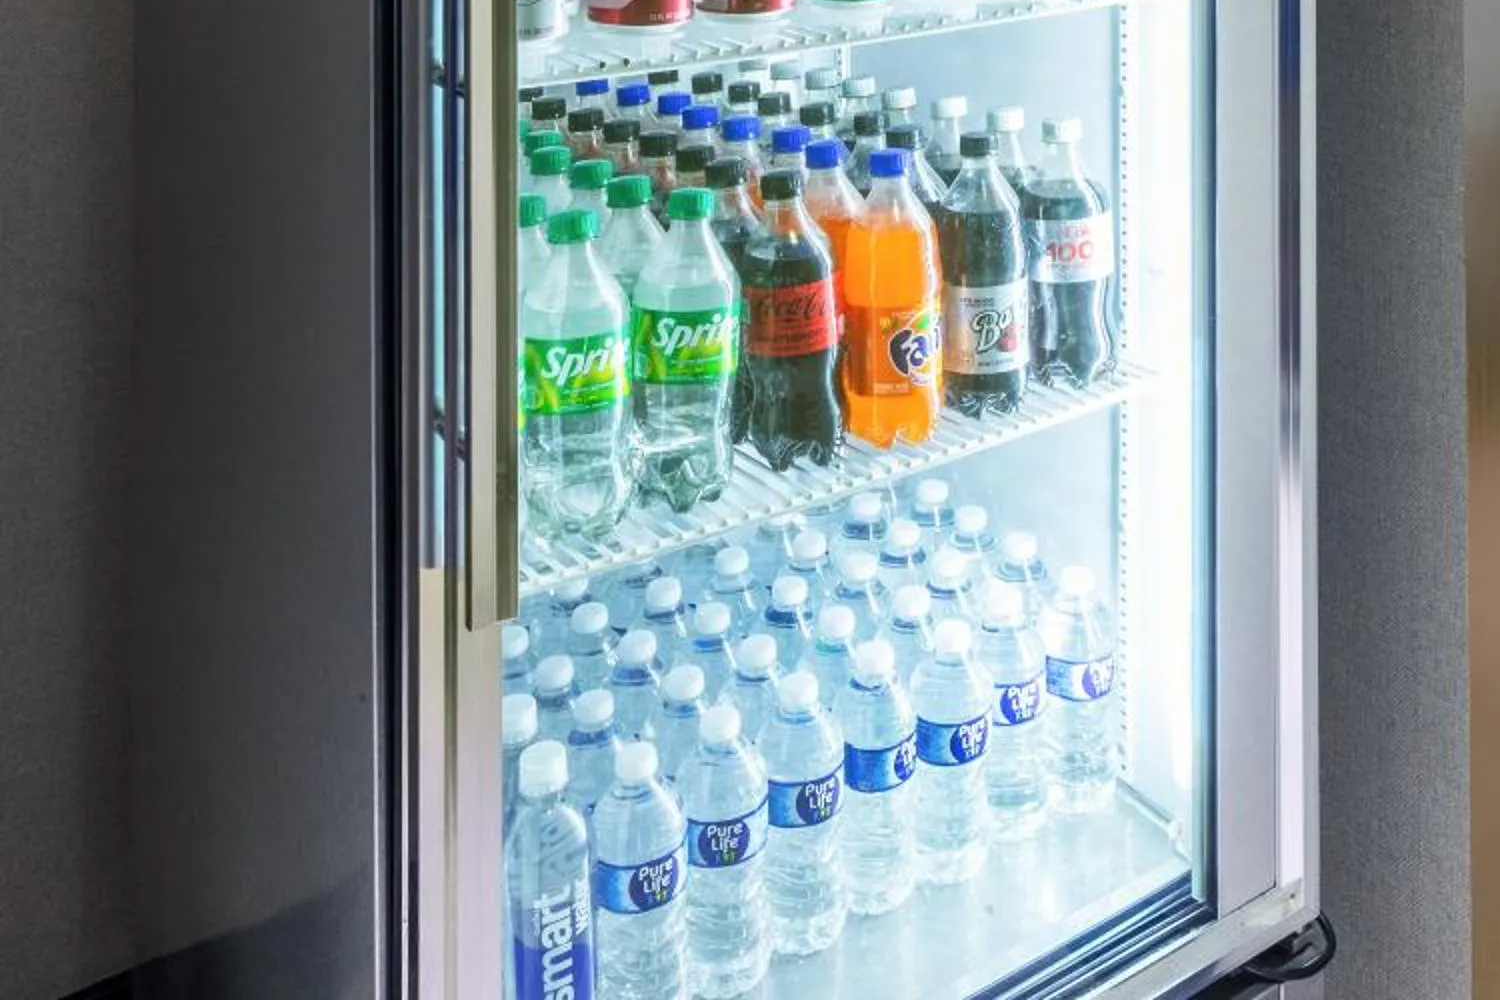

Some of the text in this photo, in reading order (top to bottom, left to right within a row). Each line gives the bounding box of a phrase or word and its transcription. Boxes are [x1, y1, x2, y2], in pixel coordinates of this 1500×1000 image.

[651, 313, 738, 355] Sprit
[806, 776, 836, 796] Pure
[810, 791, 833, 809] Life
[707, 822, 743, 839] Pure
[711, 837, 740, 853] Life
[639, 857, 673, 880] Pure
[643, 872, 671, 893] Life
